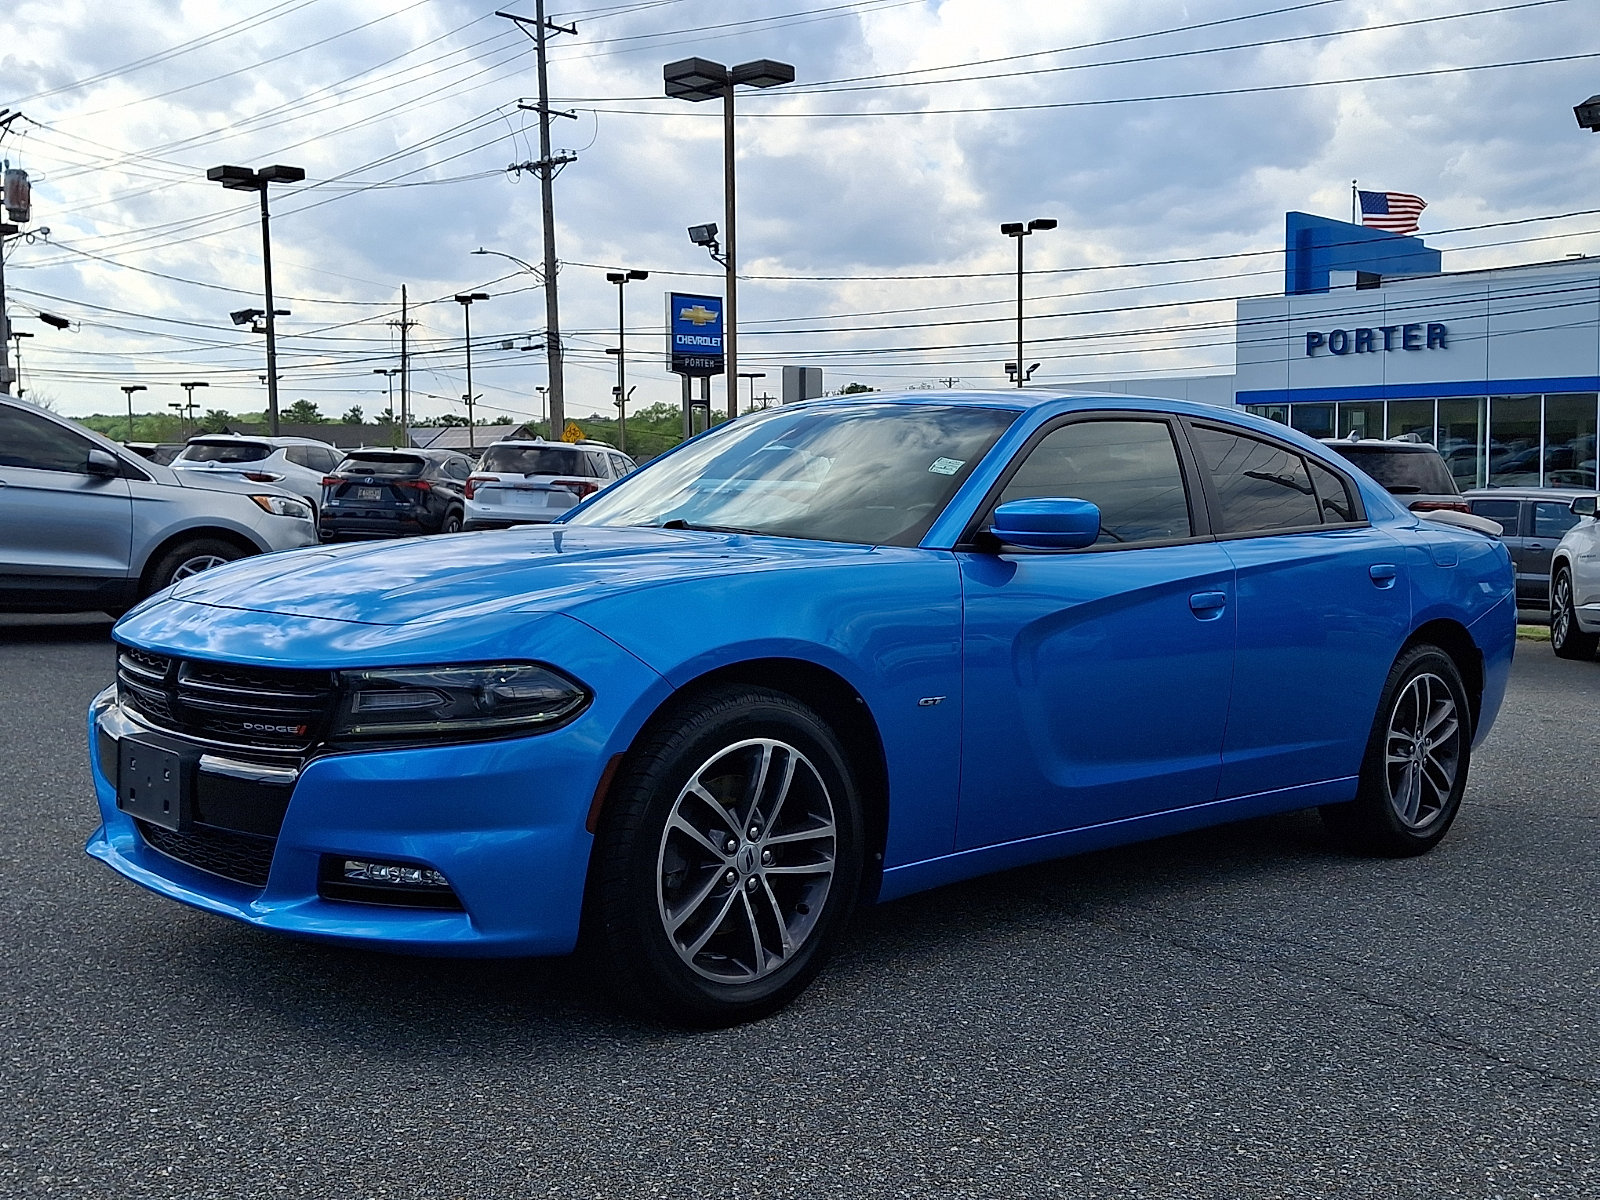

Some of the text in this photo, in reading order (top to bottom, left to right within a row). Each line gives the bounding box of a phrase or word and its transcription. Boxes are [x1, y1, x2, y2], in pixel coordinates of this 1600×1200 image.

[676, 335, 721, 347] CHEVROLET
[1305, 323, 1448, 356] PORTER
[684, 358, 715, 368] PORTER
[919, 695, 947, 706] GT
[243, 722, 299, 734] DODGE
